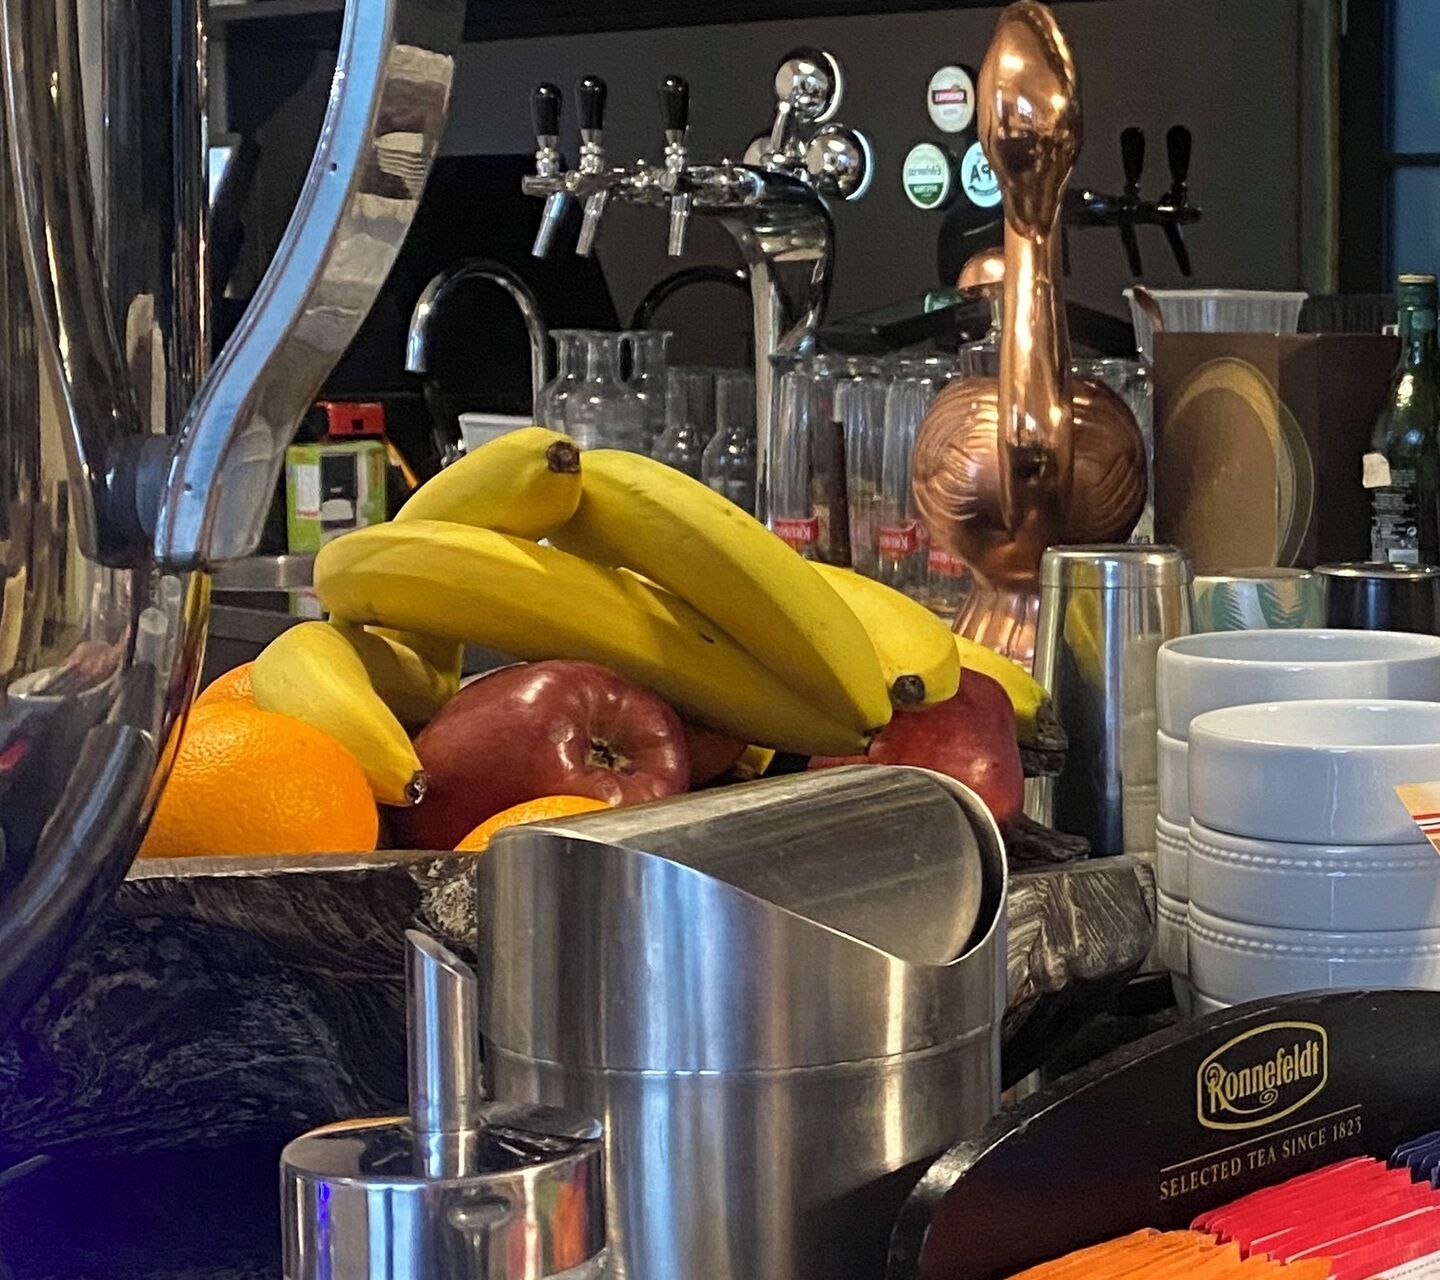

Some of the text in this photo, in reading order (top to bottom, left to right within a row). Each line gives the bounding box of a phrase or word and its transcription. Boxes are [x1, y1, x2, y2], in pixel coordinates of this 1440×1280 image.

[1204, 1039, 1320, 1115] Ronnefeldt
[1159, 1116, 1363, 1201] SELECTED TEA SINCE 1823
